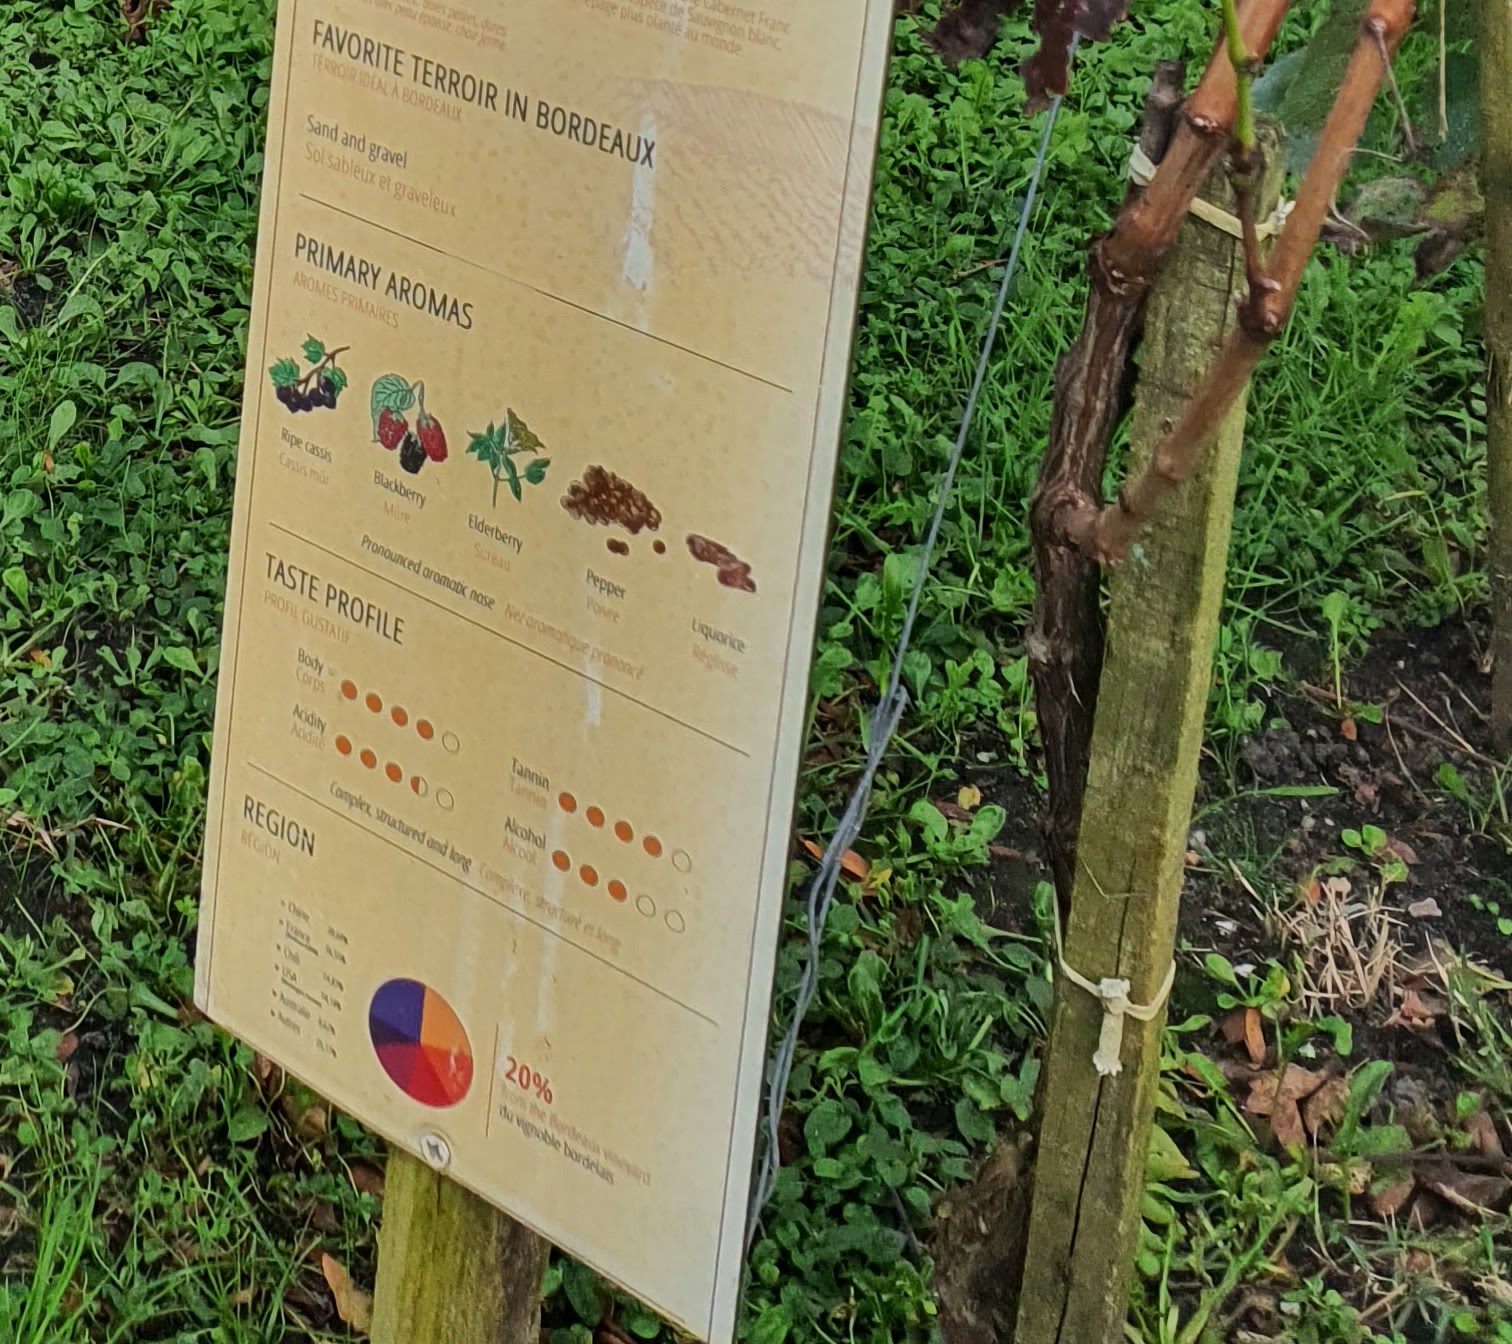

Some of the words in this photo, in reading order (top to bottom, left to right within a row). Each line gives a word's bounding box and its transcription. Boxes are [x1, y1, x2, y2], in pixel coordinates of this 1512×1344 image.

[312, 52, 357, 83] TERROIR
[401, 86, 462, 123] BORDEAUX
[312, 18, 405, 77] FAVORITE
[410, 53, 498, 112] TERROIR
[504, 88, 529, 123] IN
[535, 99, 656, 169] BORDEAUX
[306, 113, 338, 143] Sand
[340, 130, 366, 153] and
[367, 141, 408, 169] gravel
[304, 140, 325, 166] Sol
[327, 153, 376, 185] sableux
[378, 174, 392, 193] et
[392, 180, 456, 218] graveleux
[294, 231, 382, 291] PRIMARY
[384, 271, 474, 330] AROMAS
[341, 289, 399, 329] PRIMAIRES
[280, 426, 303, 449] Ripe
[304, 440, 332, 464] cassis
[373, 469, 427, 510] Blackberry
[467, 513, 523, 555] Elderberry
[360, 533, 421, 576] Pronounced
[422, 566, 468, 598] aromatic
[469, 588, 495, 611] nose
[585, 567, 626, 600] Pepper
[263, 589, 298, 620] PROFIL
[264, 551, 320, 603] TASTE
[324, 582, 405, 645] PROFILE
[295, 666, 326, 694] Corps
[297, 647, 324, 676] Body
[291, 703, 327, 736] Acidity
[511, 756, 550, 792] Tannin
[242, 794, 315, 857] REGION
[503, 815, 547, 851] Alcohol
[504, 1055, 553, 1105] 20%
[498, 1104, 514, 1124] du
